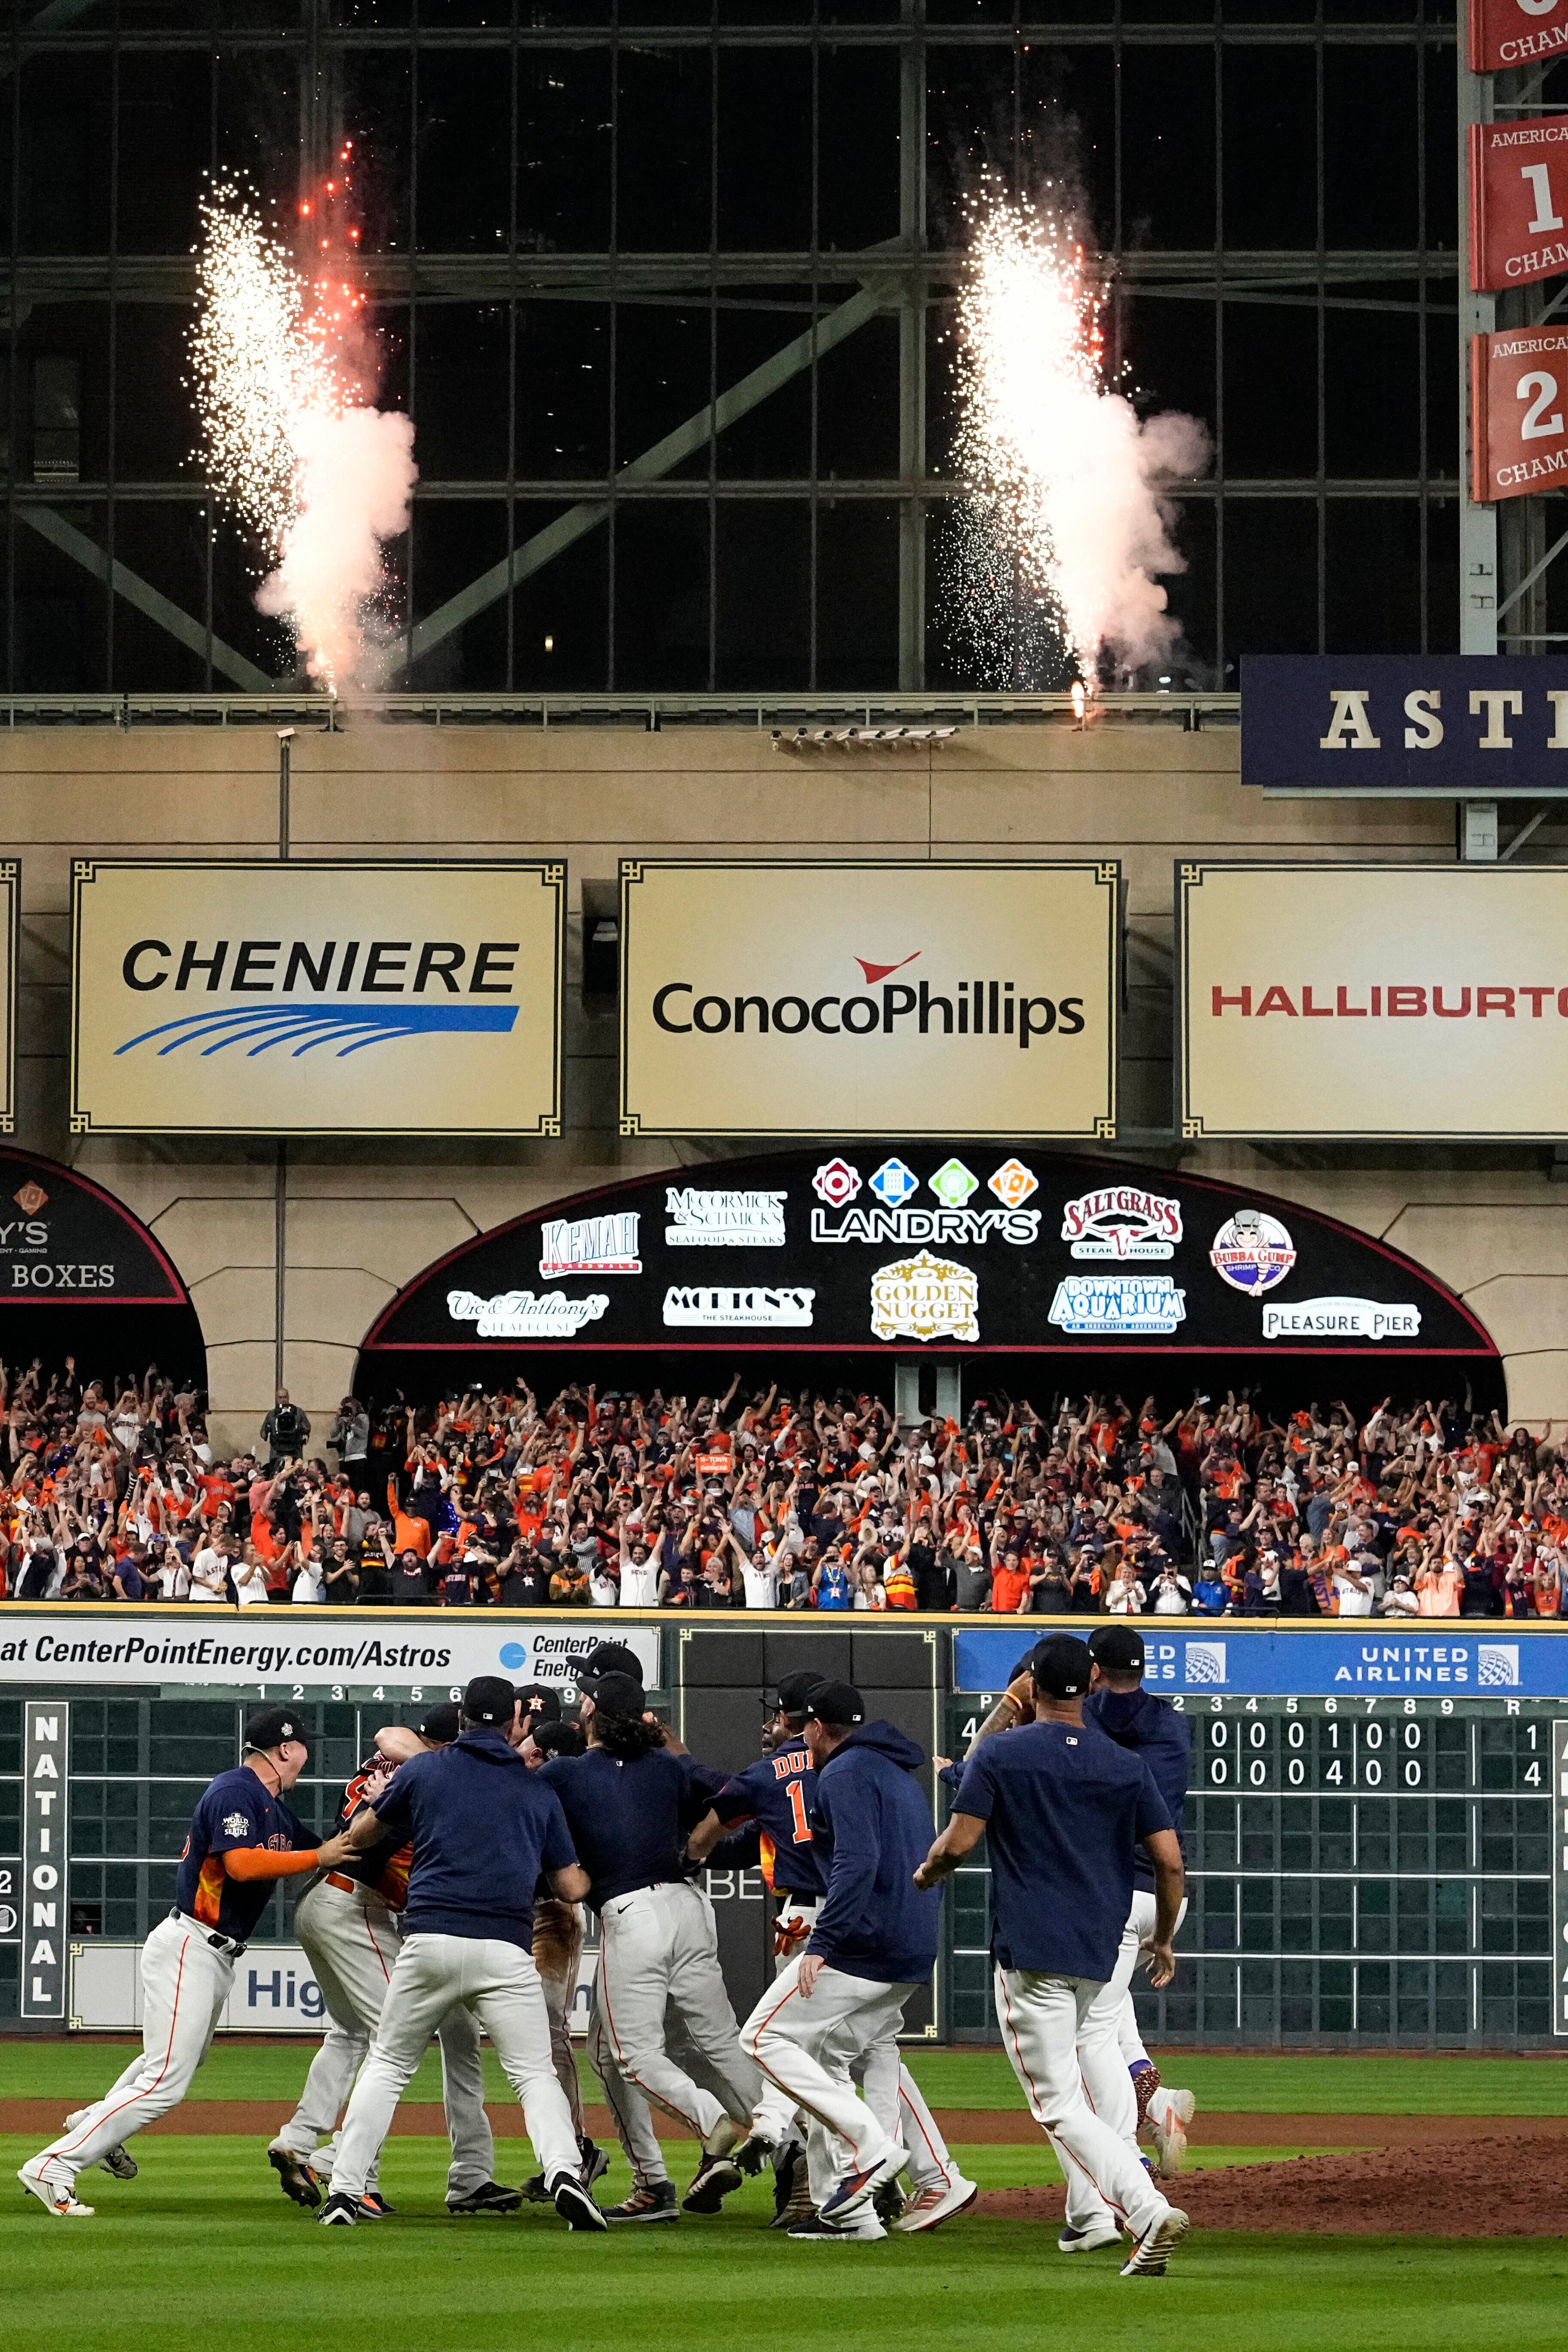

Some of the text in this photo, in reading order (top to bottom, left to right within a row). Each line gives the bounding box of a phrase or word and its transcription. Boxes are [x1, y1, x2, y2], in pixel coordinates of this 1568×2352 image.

[1521, 163, 1563, 234] 1
[1492, 337, 1568, 358] AMERICA
[1516, 371, 1564, 440] 2
[1496, 448, 1568, 486] CHAM
[123, 940, 520, 993] CHENIERE
[1212, 986, 1568, 1017] HALLIBURT
[653, 981, 1084, 1048] ConocoPhillips
[816, 1213, 1034, 1240] LANDRY'S
[545, 1215, 636, 1276] KEMAH
[1213, 1249, 1294, 1264] BUBBA GUMP
[11, 1264, 115, 1288] BOXES
[1068, 1279, 1171, 1297] DOWNTOWN
[668, 1292, 805, 1310] MORTON'S
[875, 1285, 974, 1301] GOLDEN
[1051, 1285, 1184, 1322] AQUARIUM
[452, 1296, 484, 1315] Vic
[507, 1296, 600, 1322] Anthony's
[876, 1302, 974, 1319] NUGGET
[1269, 1313, 1413, 1334] PLEASURE PIER
[0, 1636, 451, 1672] at CenterPointEnergy.com/Astros
[1362, 1648, 1468, 1662] UNITED
[1334, 1667, 1468, 1682] AIRLINES
[257, 1685, 576, 1704] 1 2 3 4 5 6 9
[980, 1694, 992, 1709] P
[1173, 1696, 1520, 1715] 2 3 4 5 6 7 8 9 R
[1212, 1721, 1536, 1749] 0 0 0 1 0 0 1
[1211, 1758, 1541, 1787] 0 0 0 4 0 0 4
[224, 1828, 248, 1836] SERIES
[30, 1716, 59, 2002] NATIONAL
